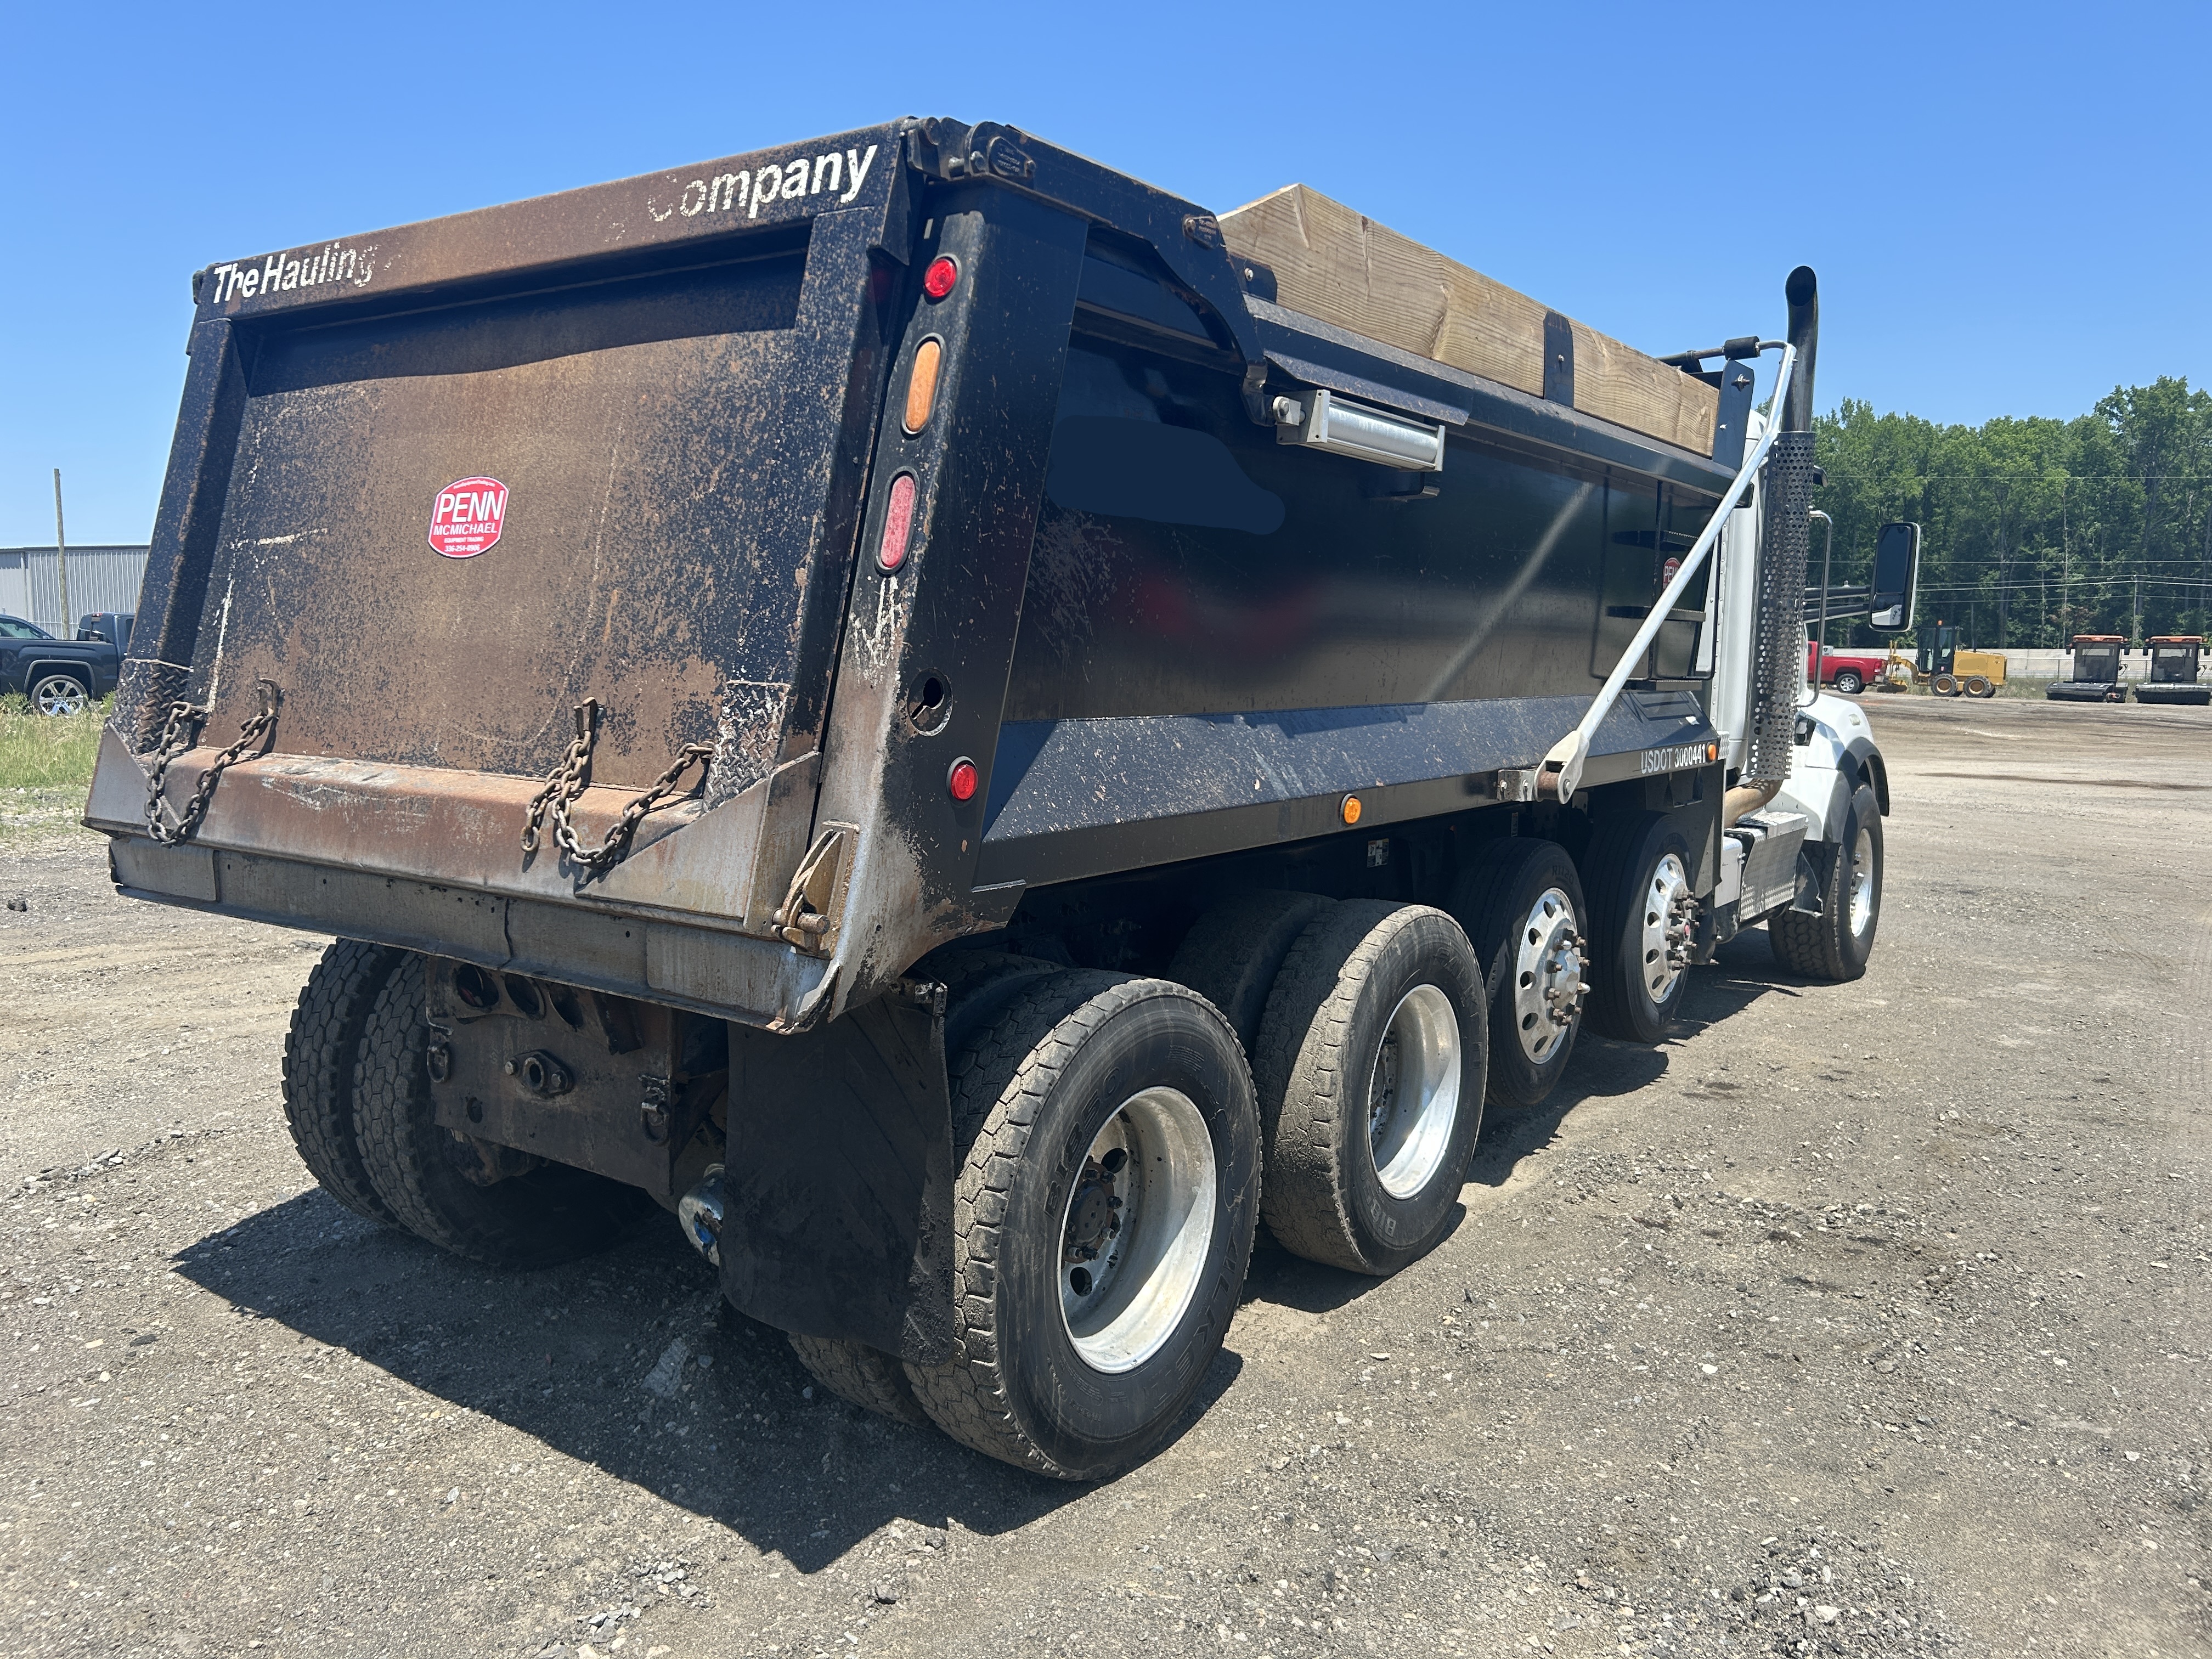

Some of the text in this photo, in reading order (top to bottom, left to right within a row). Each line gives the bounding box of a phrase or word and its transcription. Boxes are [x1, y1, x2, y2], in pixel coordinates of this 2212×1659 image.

[213, 242, 381, 303] The Hauling
[436, 490, 505, 524] PENN
[433, 522, 498, 535] MCMICHAEL
[1663, 566, 1678, 583] PEN
[1641, 744, 1706, 774] USDOT 3000441
